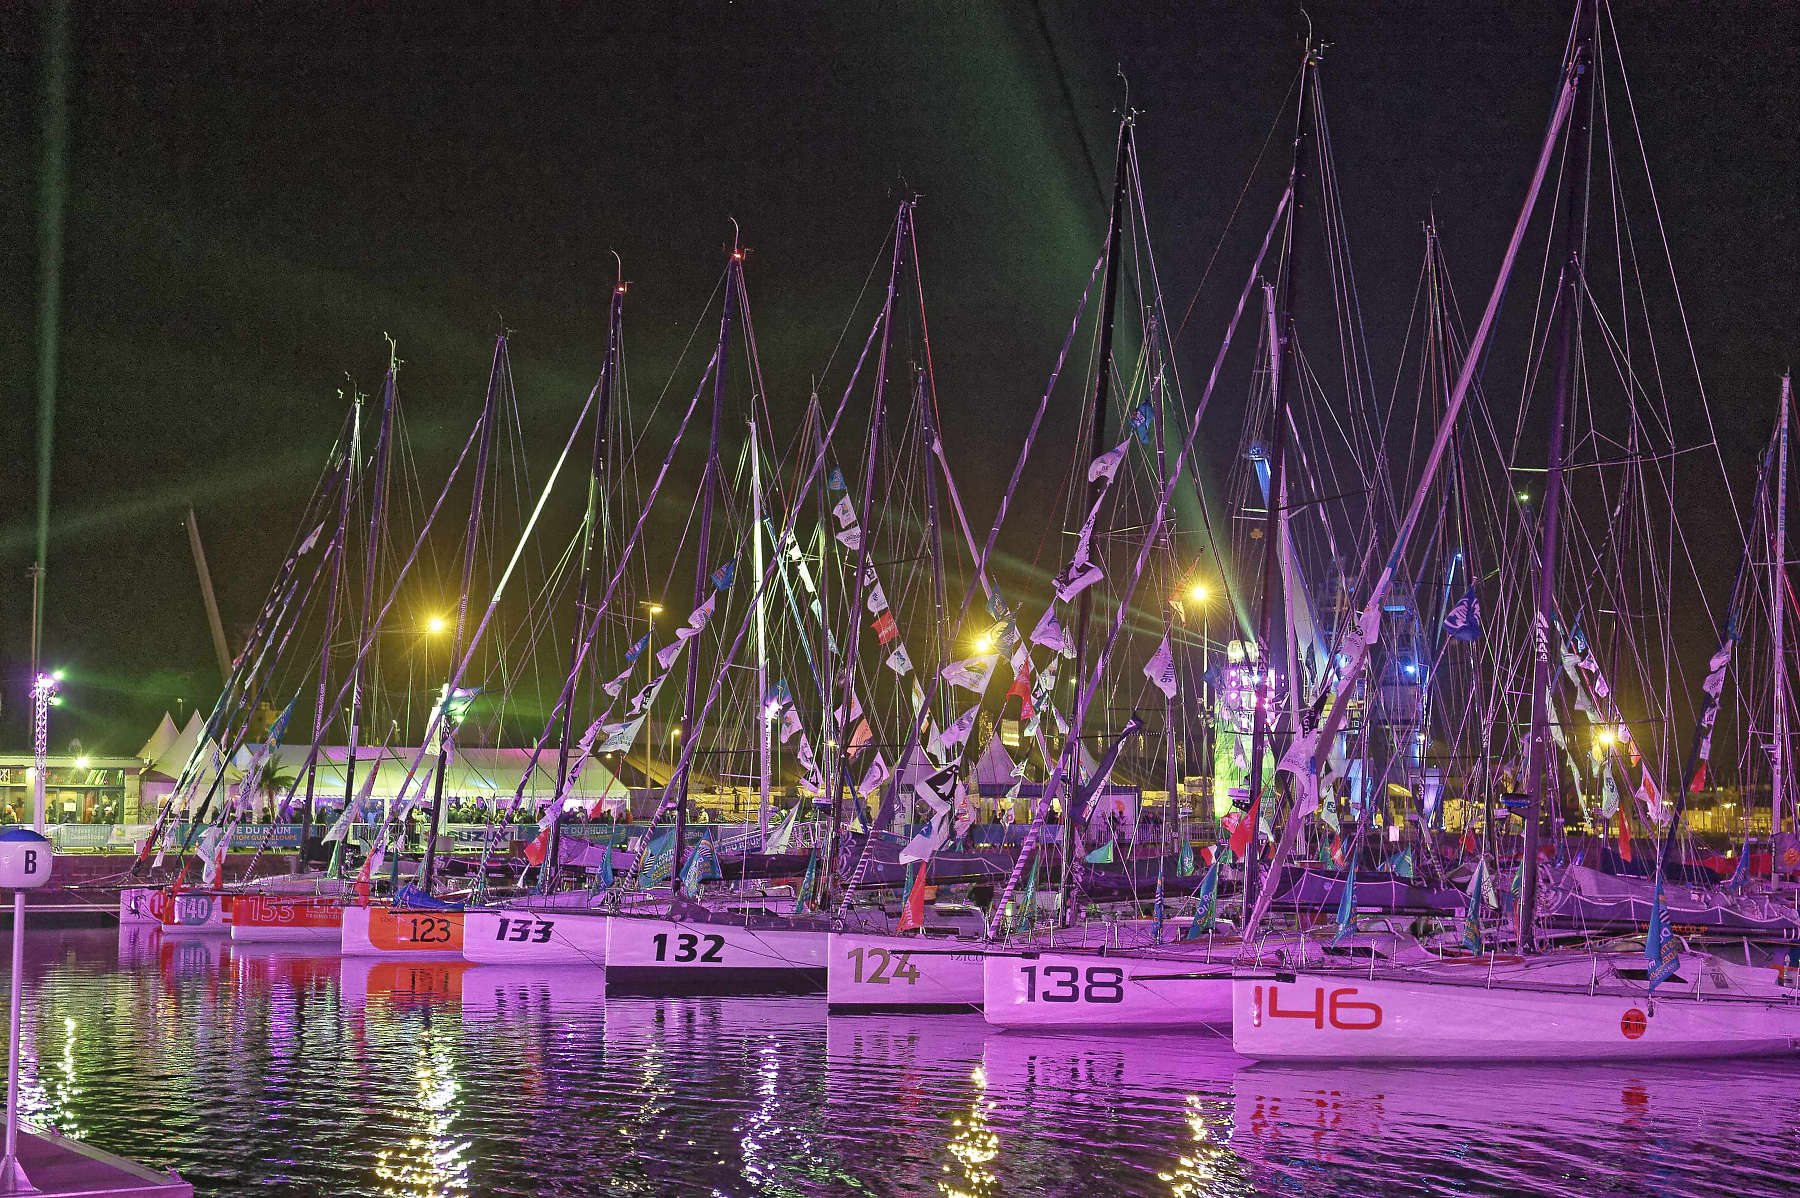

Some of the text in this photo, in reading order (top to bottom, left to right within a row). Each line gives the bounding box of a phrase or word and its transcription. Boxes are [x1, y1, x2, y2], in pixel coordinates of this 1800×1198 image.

[245, 826, 260, 835] DU
[263, 826, 291, 835] RUM
[24, 850, 37, 875] B
[180, 898, 209, 920] 140
[248, 896, 296, 923] 153
[409, 918, 451, 943] 123
[496, 918, 555, 944] 133
[653, 933, 726, 963] 132
[847, 947, 921, 985] 124
[1020, 965, 1124, 1004] 138
[1253, 985, 1383, 1030] 146
